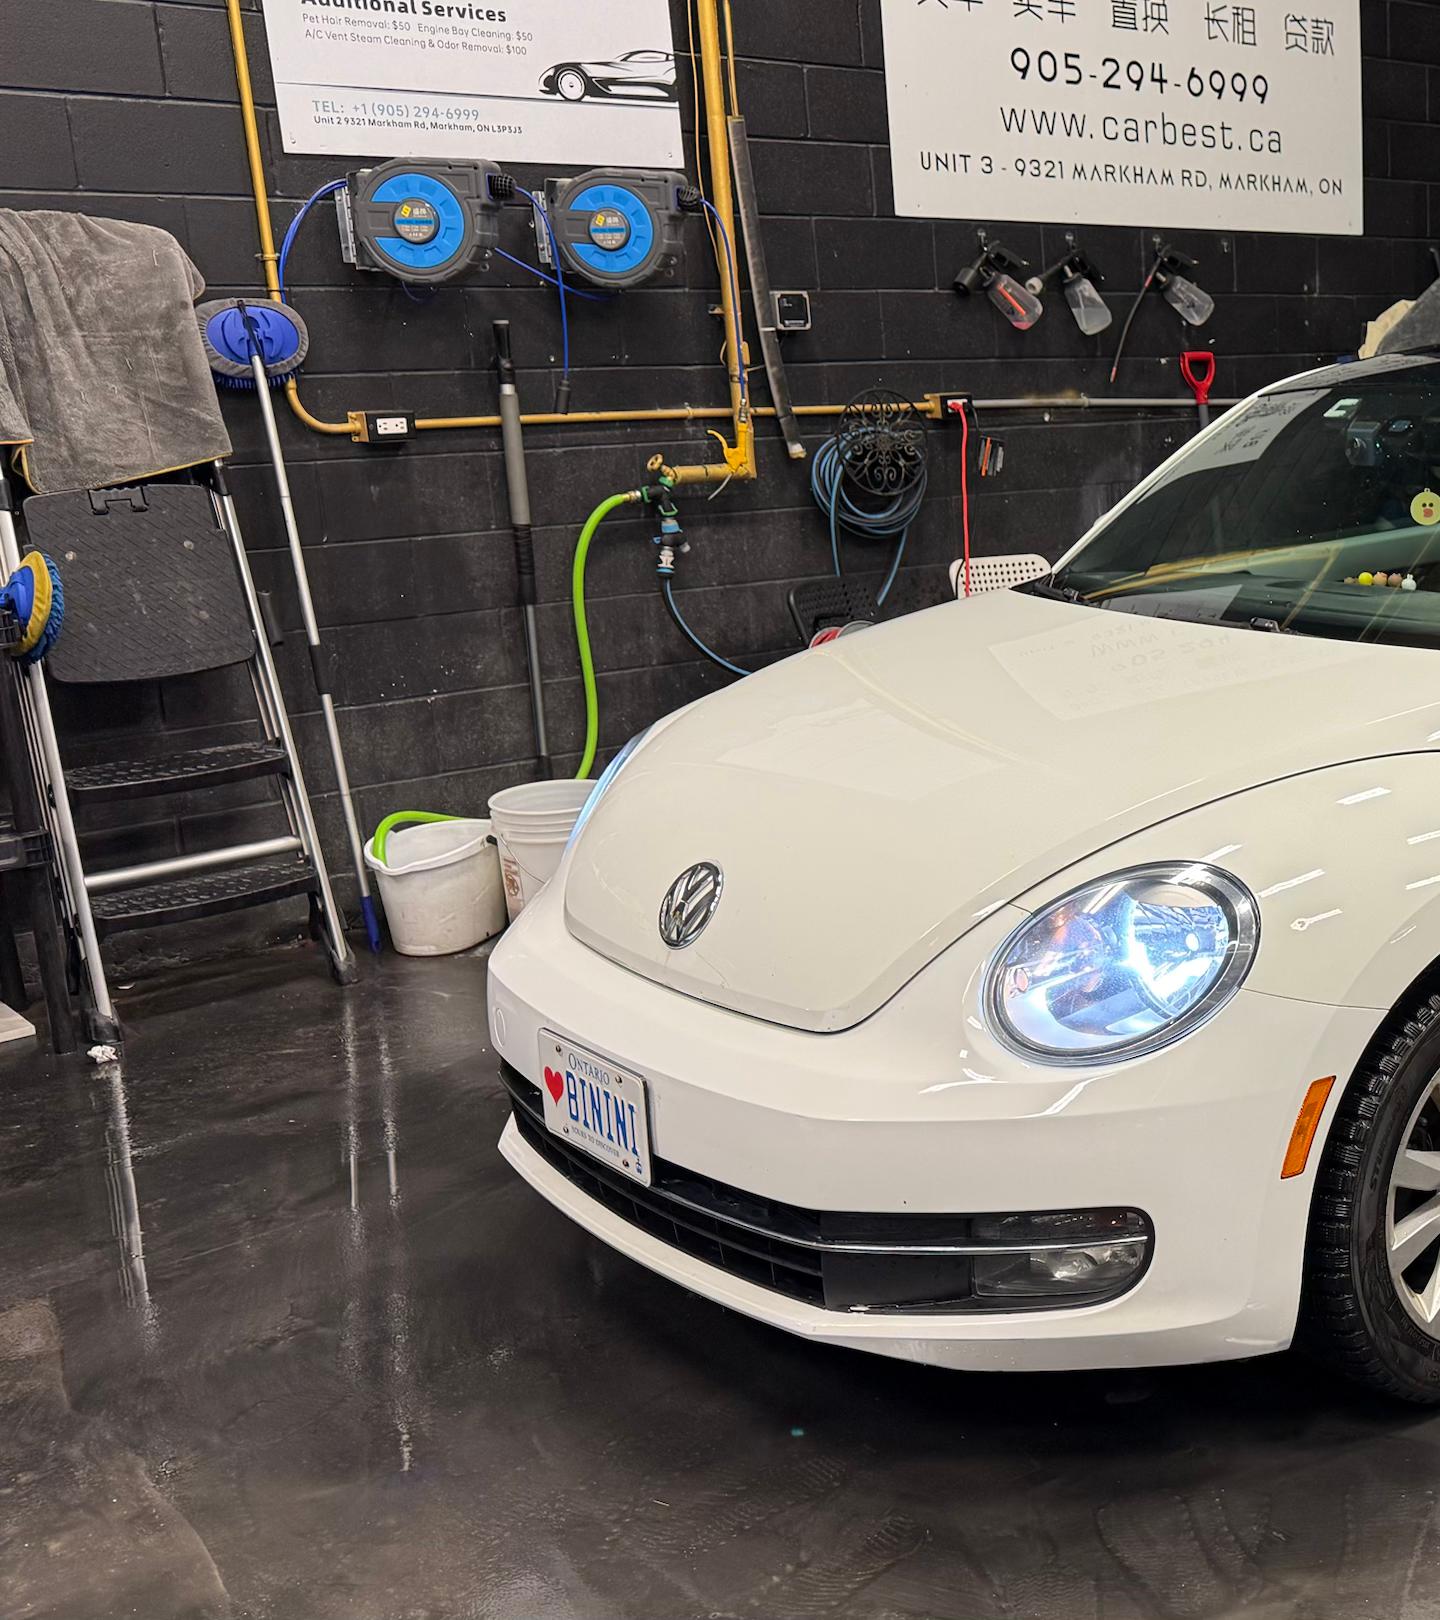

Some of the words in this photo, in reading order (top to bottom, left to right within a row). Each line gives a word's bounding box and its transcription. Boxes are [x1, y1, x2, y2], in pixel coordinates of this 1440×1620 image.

[301, 0, 417, 14] itional
[422, 0, 507, 22] Services
[302, 13, 322, 24] Pet
[322, 16, 342, 26] Hair
[344, 17, 391, 29] Removal:
[392, 20, 411, 31] $50
[418, 23, 450, 35] Engine
[452, 26, 469, 37] Bay
[471, 28, 514, 41] Cleaning:
[516, 30, 533, 41] $50
[1111, 0, 1169, 35] 置换
[1204, 2, 1257, 46] 长租
[1285, 13, 1335, 56] 贷款
[305, 29, 323, 40] A/C
[325, 31, 348, 42] Vent
[350, 32, 382, 44] Steam
[384, 35, 426, 49] Cleaning
[428, 39, 435, 48] &
[437, 40, 459, 50] Odor
[462, 42, 504, 53] Removal:
[506, 45, 527, 55] $100
[1010, 47, 1269, 104] 905-294-6999
[312, 100, 344, 113] TEL:
[352, 103, 367, 115] +1
[372, 102, 409, 118] (905)
[413, 106, 479, 121] 294-6999
[313, 116, 334, 125] Unit
[336, 116, 342, 125] 2
[344, 117, 366, 126] 9321
[368, 118, 412, 128] Markham
[413, 121, 429, 130] Rd,
[430, 121, 476, 132] Markham,
[476, 124, 490, 132] ON
[1000, 106, 1282, 154] www.carbest.ca
[920, 151, 972, 174] UNIT
[981, 156, 994, 175] 3
[1014, 159, 1065, 180] 9321
[1072, 163, 1175, 187] MARKHAM
[1182, 169, 1212, 190] RD,
[1219, 172, 1314, 197] MARKHAM,
[1319, 178, 1343, 196] ON
[565, 1070, 640, 1156] BININI
